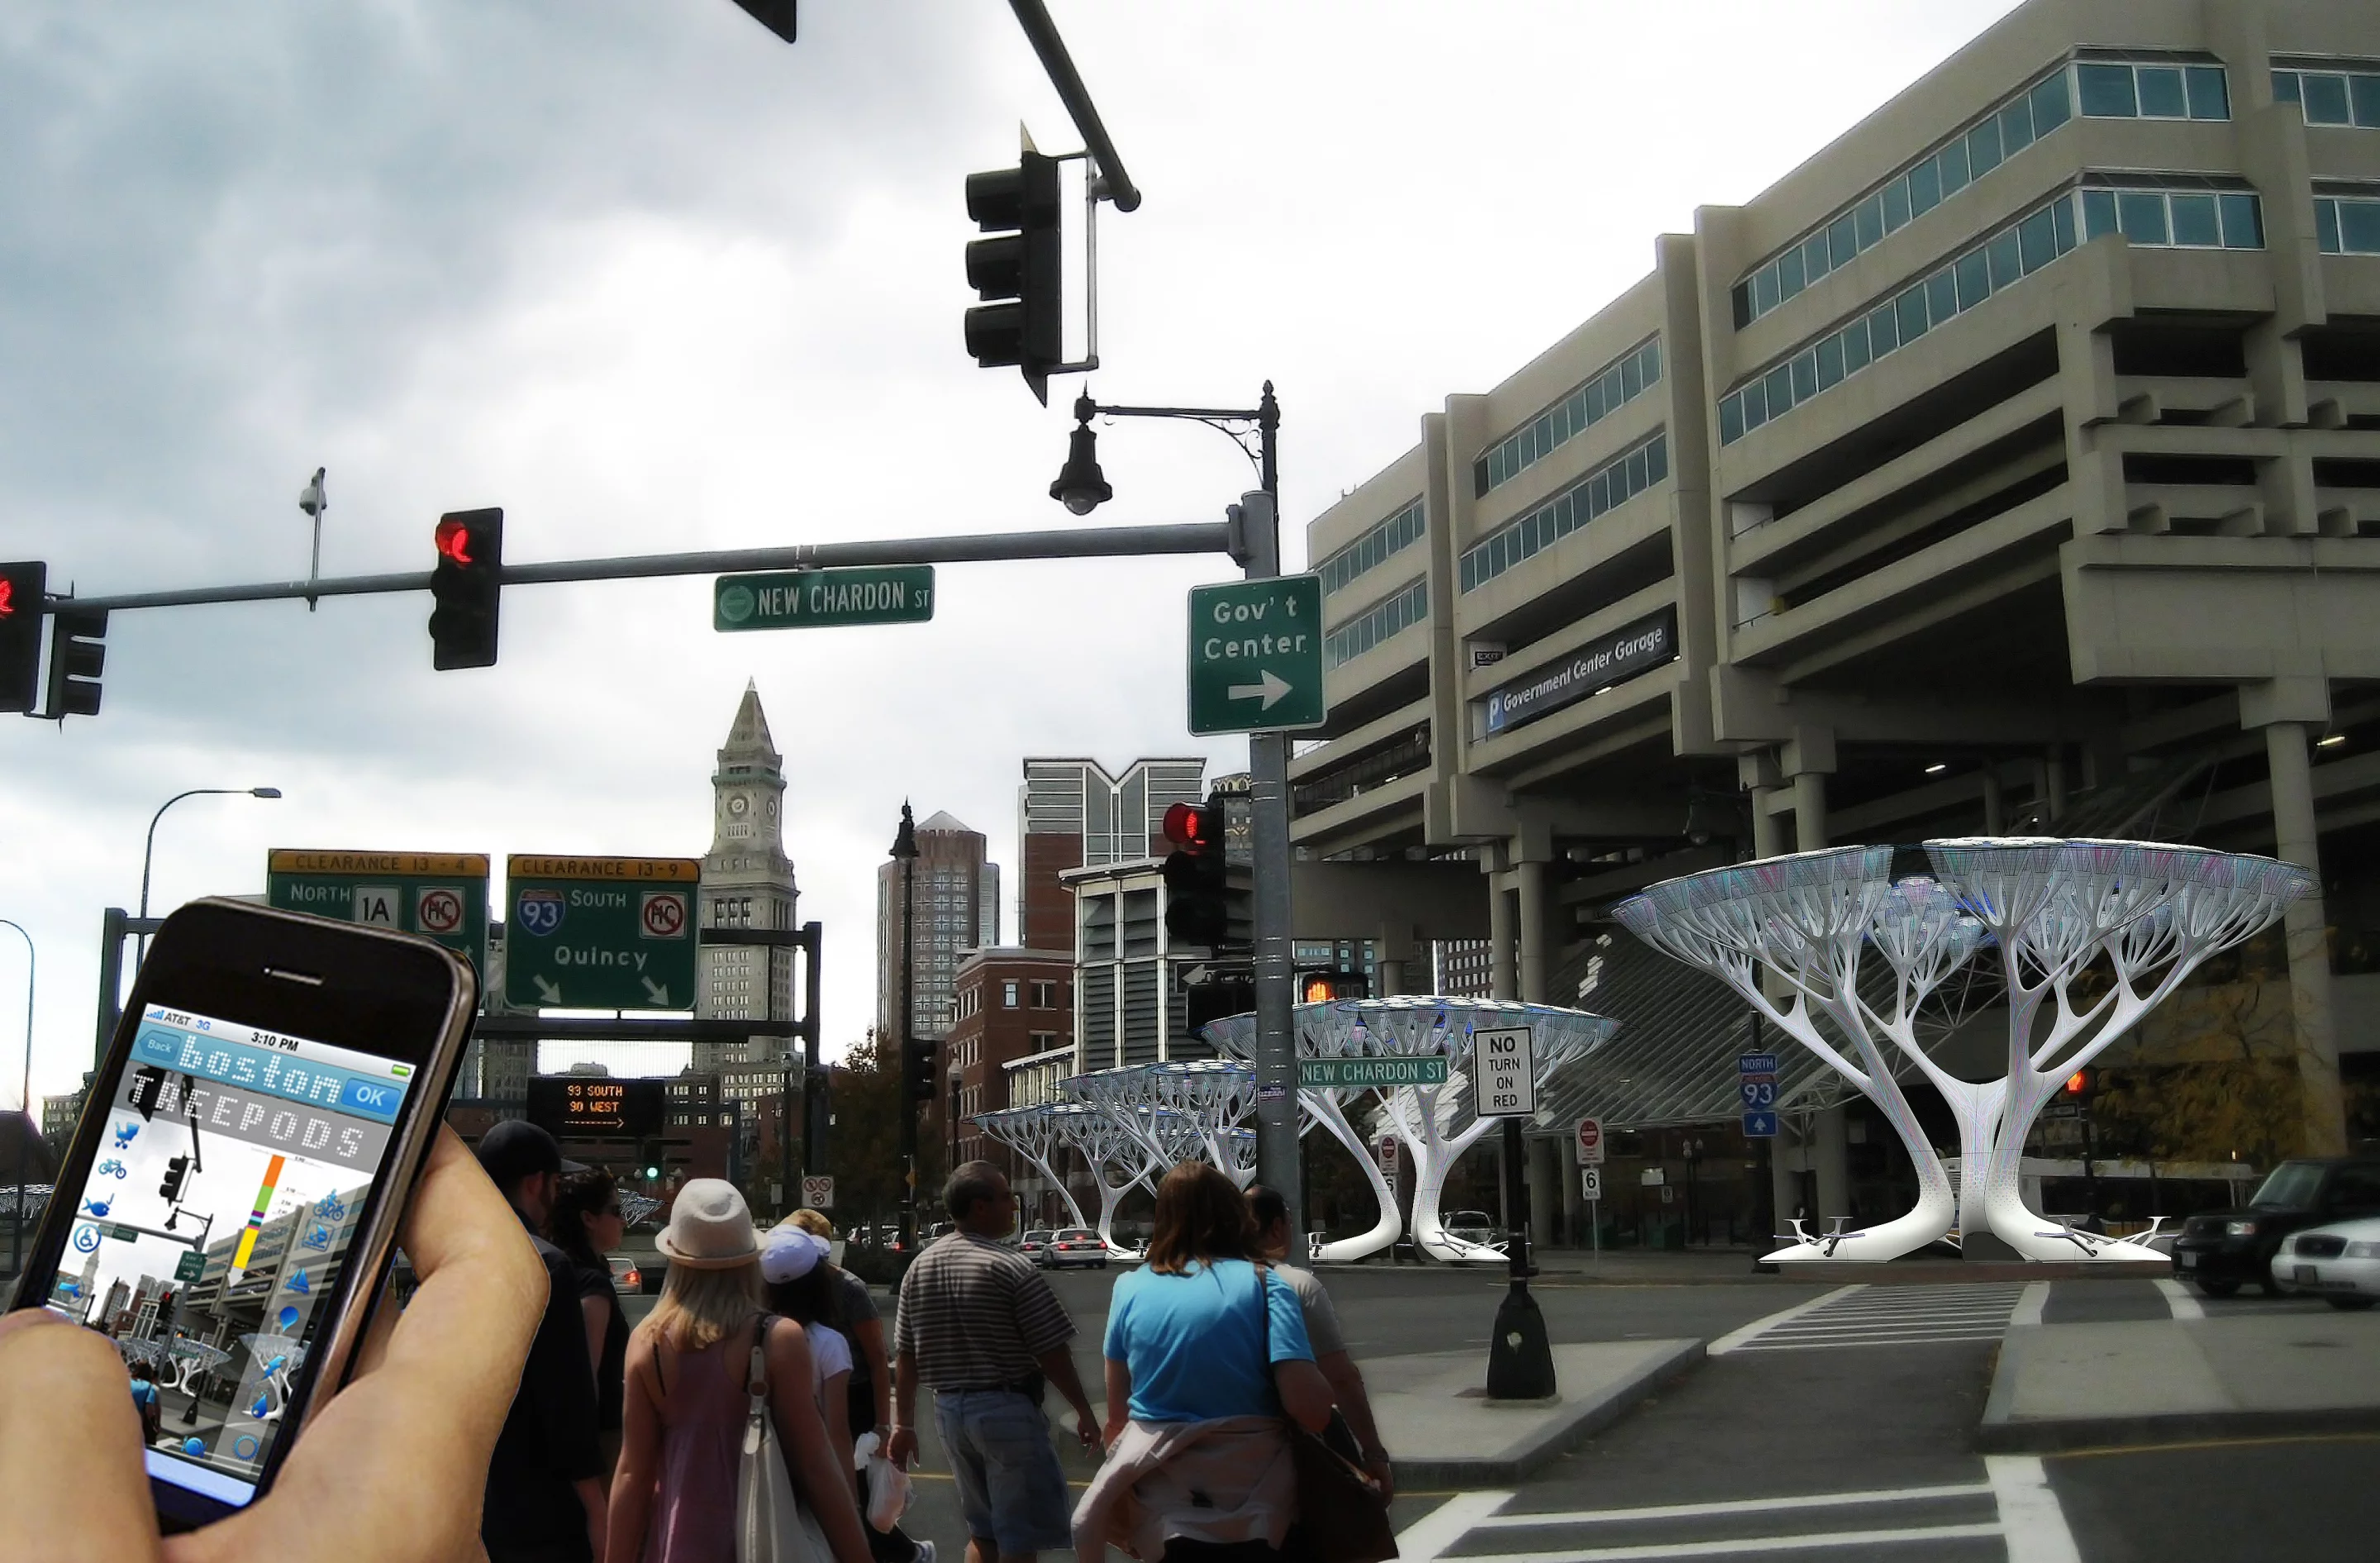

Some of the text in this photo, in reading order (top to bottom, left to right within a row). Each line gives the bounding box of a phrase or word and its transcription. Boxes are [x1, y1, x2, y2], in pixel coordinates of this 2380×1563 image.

[758, 587, 799, 616] NEW
[810, 581, 905, 613] CHARDON
[915, 589, 931, 608] ST
[1205, 633, 1307, 660] Center
[1503, 666, 1571, 712] Government
[1573, 649, 1612, 679] Center
[1615, 626, 1664, 661] Garage
[296, 855, 402, 871] CLEARANCE
[522, 860, 626, 876] CLEARANCE
[291, 883, 351, 903] NORTH
[570, 889, 626, 908] SOUTH
[362, 897, 390, 922] 1A
[523, 901, 558, 927] 93
[555, 946, 648, 972] Quincy
[164, 1012, 212, 1032] AT&T 3G
[147, 1038, 173, 1054] Back
[251, 1032, 299, 1052] 3:10 PM
[1490, 1036, 1516, 1054] NO
[178, 1035, 342, 1104] boston
[1302, 1061, 1445, 1082] NEW CHARDON ST
[1488, 1057, 1521, 1072] TURN
[1742, 1059, 1774, 1070] NORTH
[567, 1084, 623, 1097] 93 SOUTH
[1496, 1075, 1513, 1089] ON
[355, 1085, 383, 1107] OK
[1493, 1094, 1518, 1108] RED
[1744, 1083, 1773, 1104] 93
[132, 1073, 364, 1158] TREEPODS
[569, 1100, 620, 1113] 90 WEST
[1586, 1171, 1597, 1189] 6
